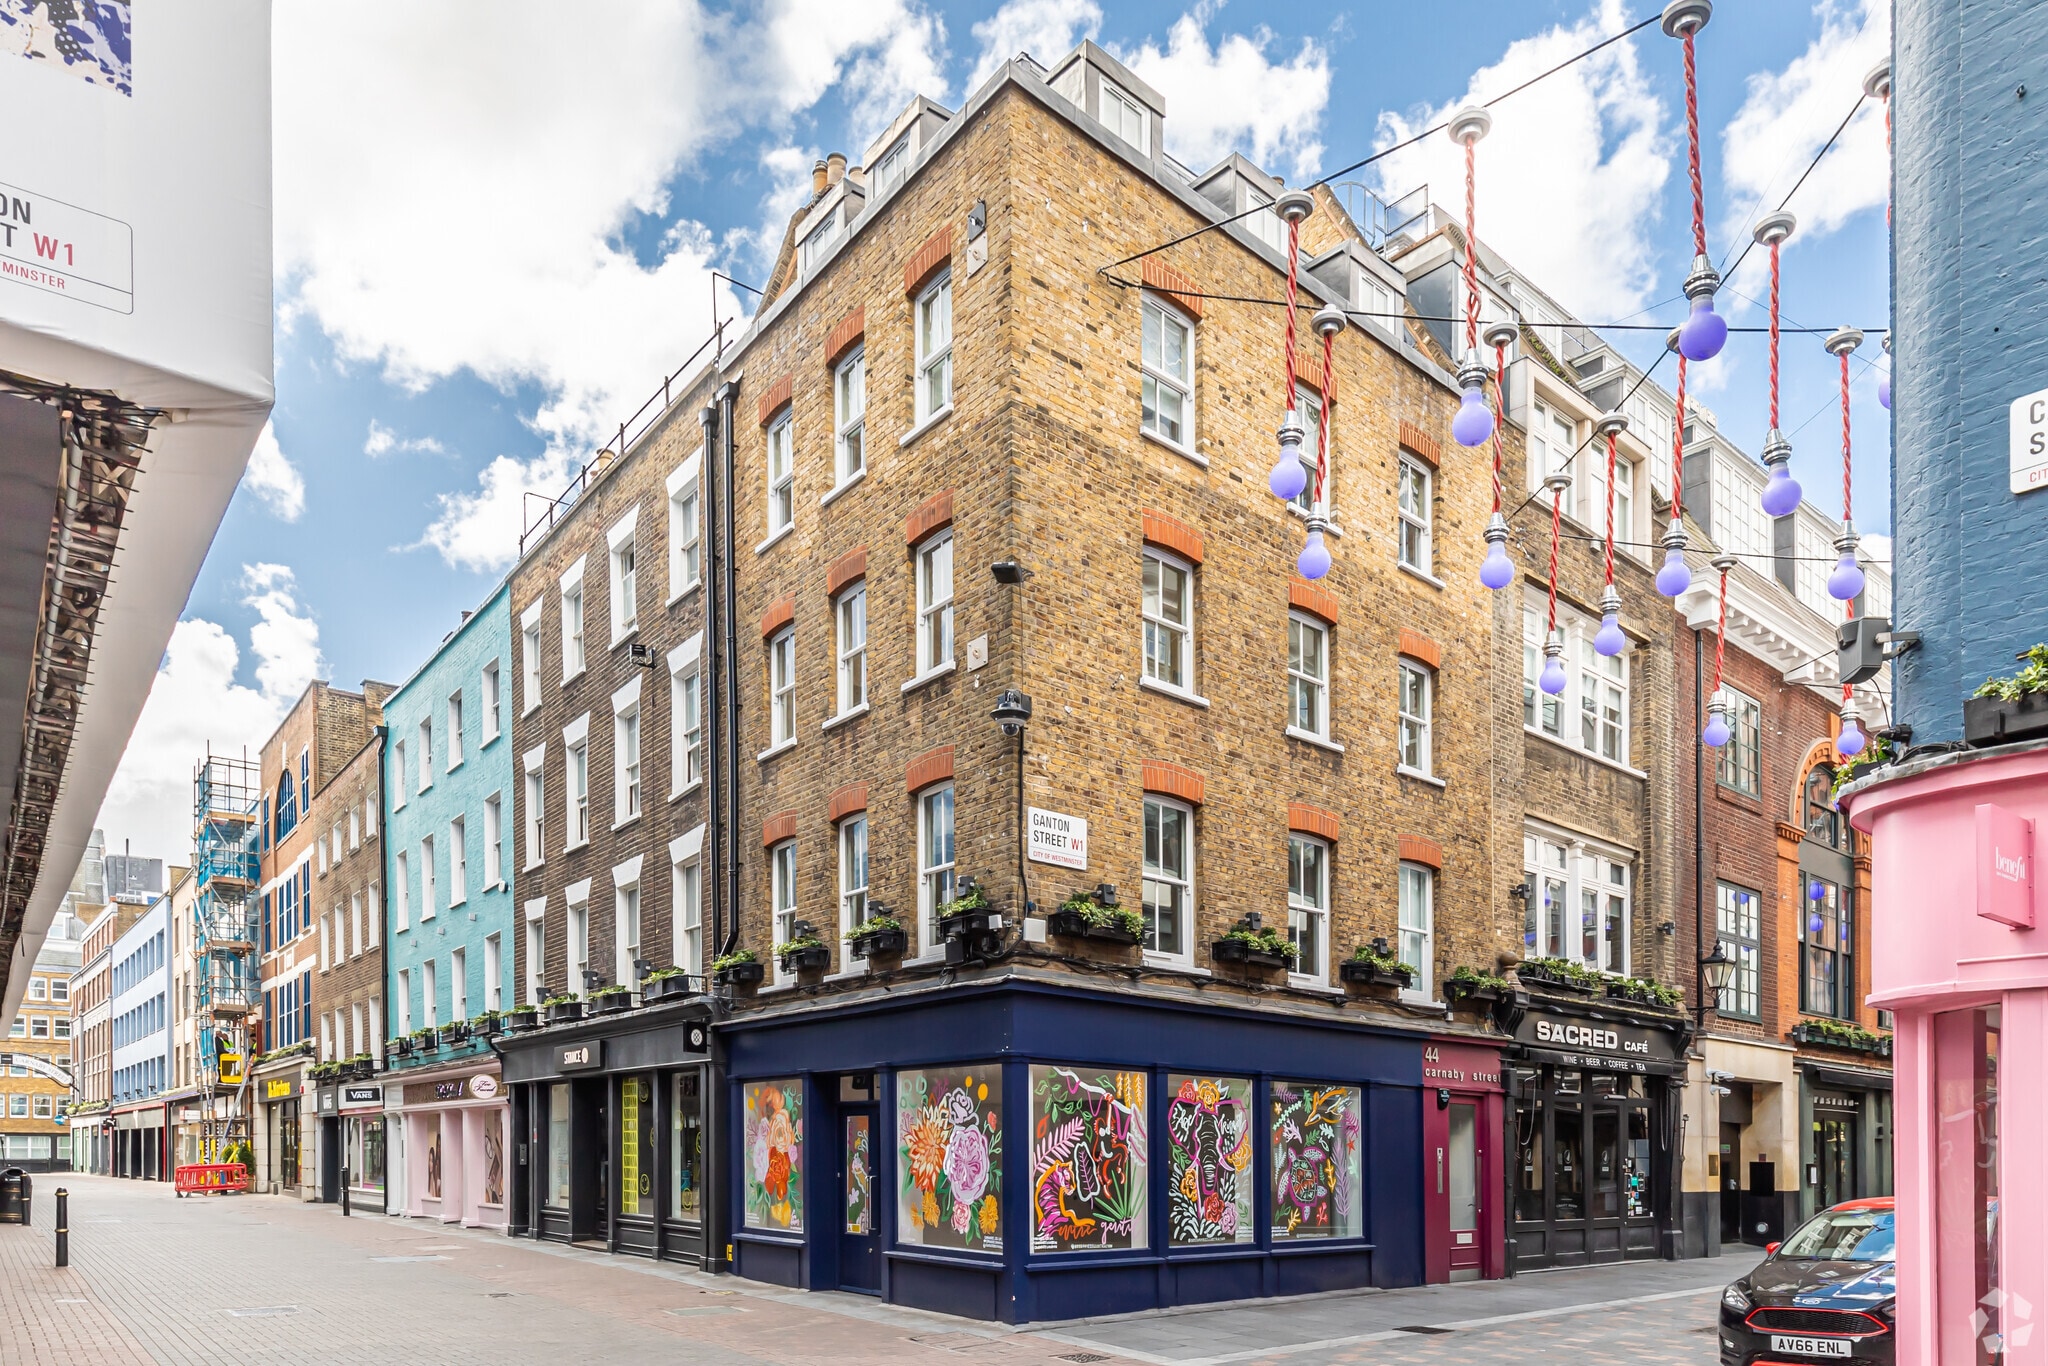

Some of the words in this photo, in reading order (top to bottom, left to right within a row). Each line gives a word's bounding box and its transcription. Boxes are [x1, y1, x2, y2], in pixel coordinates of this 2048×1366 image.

[33, 231, 73, 267] W1
[1033, 813, 1070, 833] GANTON
[1033, 829, 1067, 849] STREET
[1070, 837, 1084, 852] W1
[1033, 850, 1044, 858] CITY
[1044, 852, 1051, 860] OF
[1051, 854, 1083, 866] WESTMINSTER
[1995, 846, 2026, 882] benefit
[1536, 1020, 1618, 1050] SACRED
[1624, 1040, 1649, 1054] CAFÉ
[563, 1048, 582, 1065] STANCE
[1425, 1046, 1440, 1063] 44
[1562, 1055, 1578, 1065] WINE
[1585, 1057, 1601, 1067] BEER
[1608, 1059, 1629, 1071] COFFEE
[1635, 1062, 1647, 1072] TEA
[1425, 1067, 1465, 1082] carnaby
[350, 1090, 373, 1100] VANS
[1778, 1338, 1813, 1352] AV66
[1817, 1341, 1845, 1355] ENL
